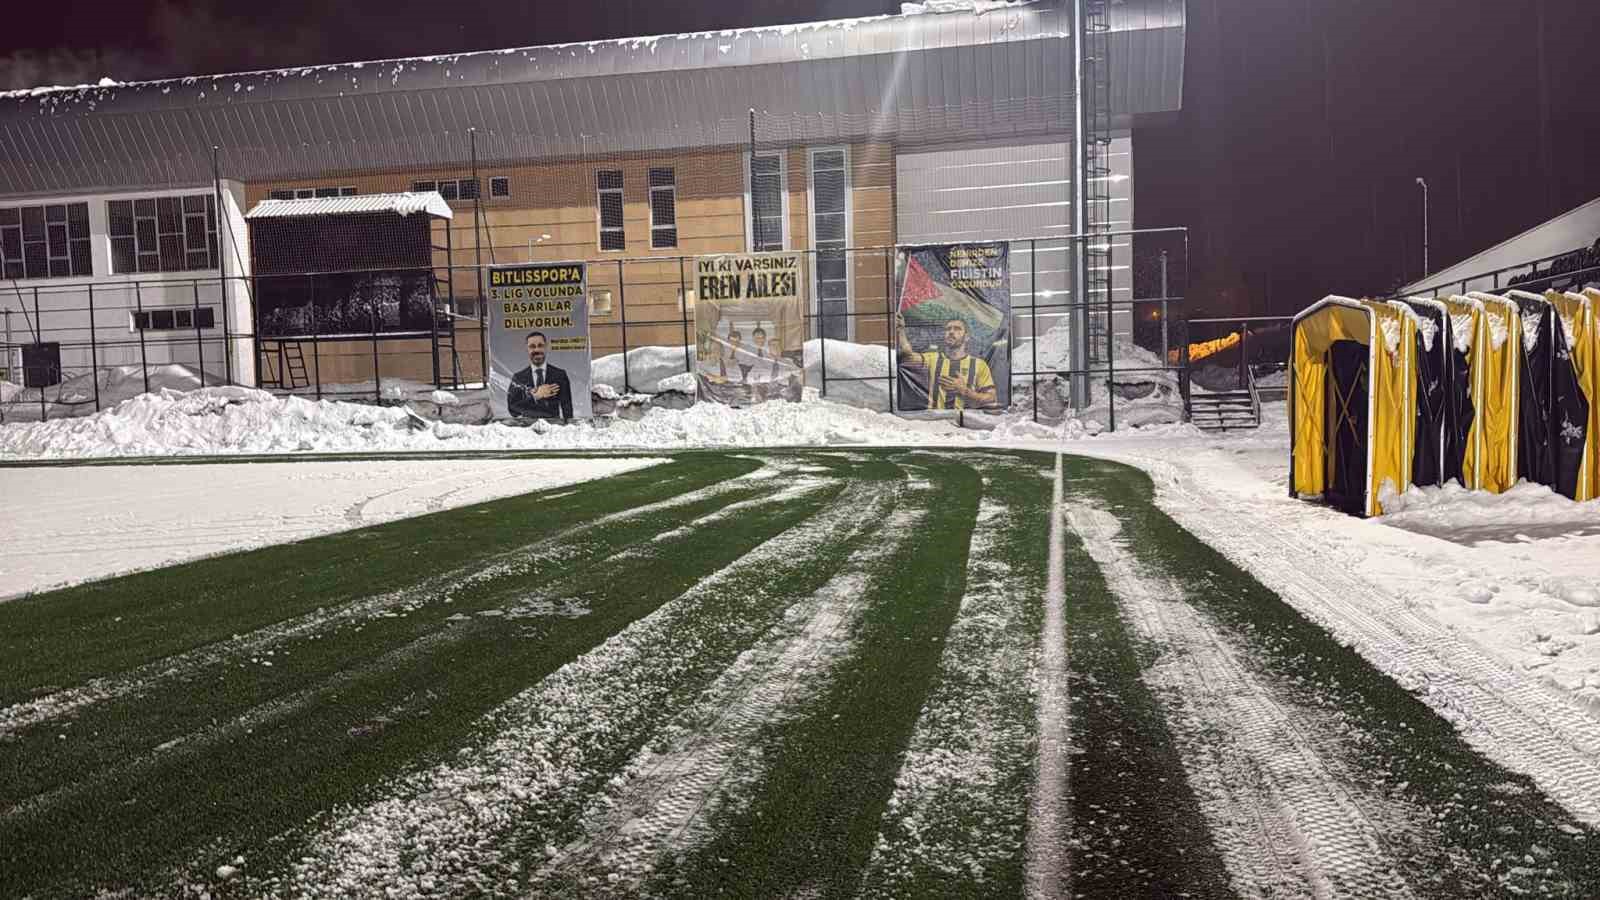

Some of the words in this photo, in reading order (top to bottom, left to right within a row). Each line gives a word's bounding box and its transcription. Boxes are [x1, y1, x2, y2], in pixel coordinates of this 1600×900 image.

[491, 289, 500, 299] 3.
[527, 286, 583, 298] YOLUNDA
[699, 274, 741, 300] EREN
[504, 301, 572, 313] BAŞARILAR
